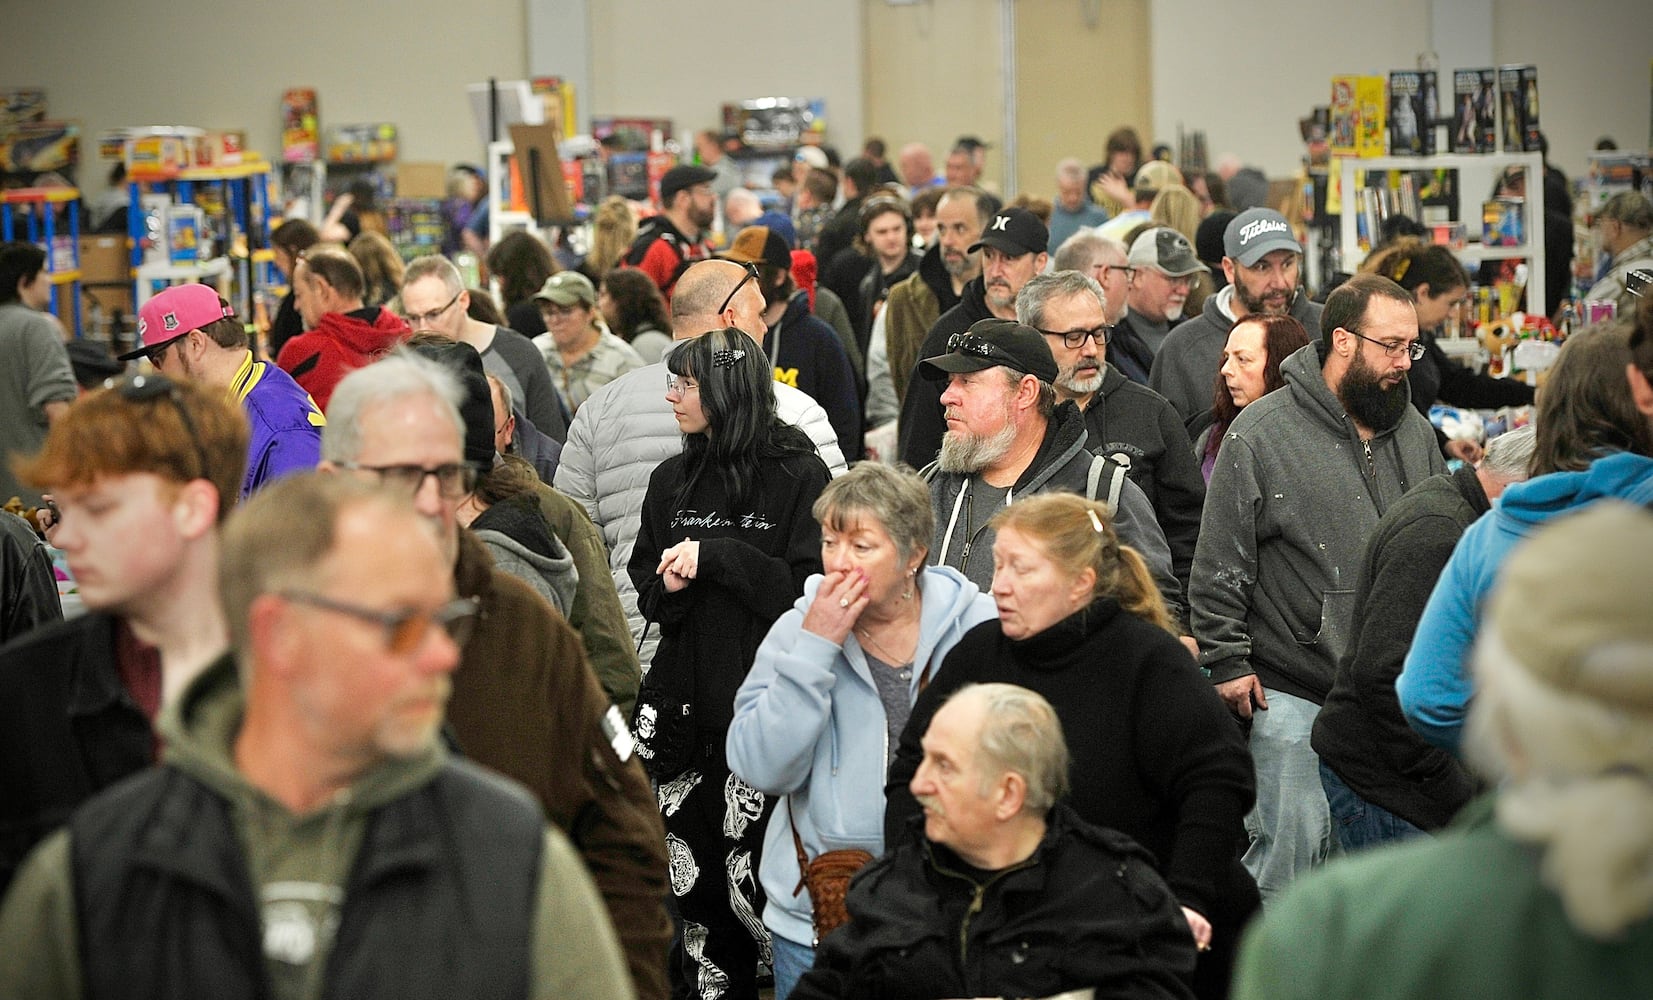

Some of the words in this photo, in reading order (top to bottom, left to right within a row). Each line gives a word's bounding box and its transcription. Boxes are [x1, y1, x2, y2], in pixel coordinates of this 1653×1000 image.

[1239, 219, 1287, 245] Titleist
[772, 366, 799, 388] M
[670, 509, 777, 530] Frankentein
